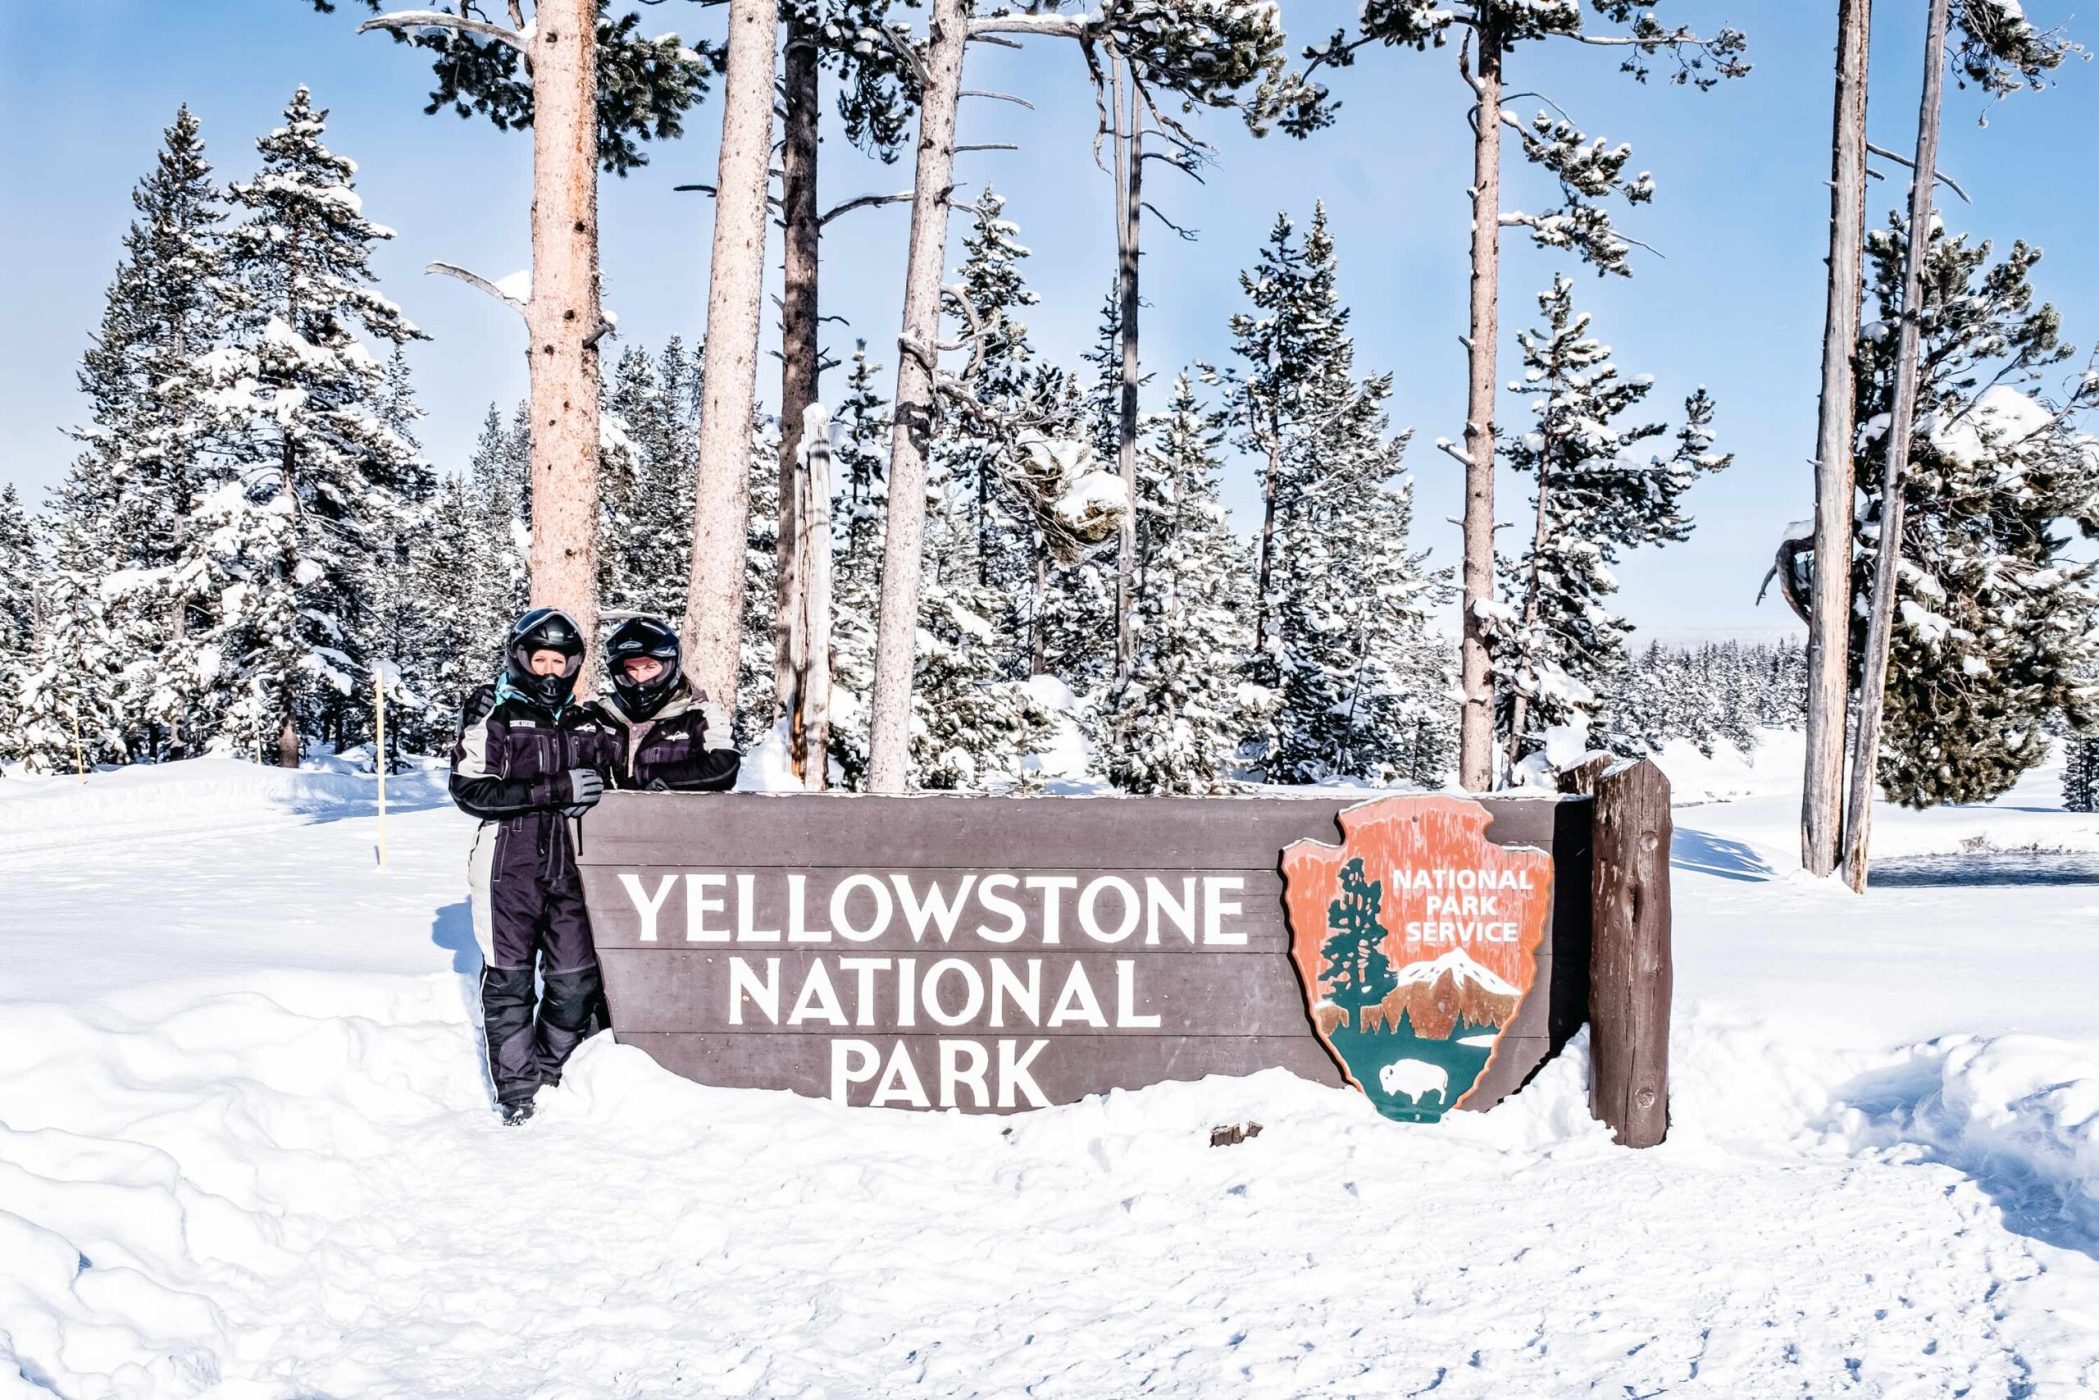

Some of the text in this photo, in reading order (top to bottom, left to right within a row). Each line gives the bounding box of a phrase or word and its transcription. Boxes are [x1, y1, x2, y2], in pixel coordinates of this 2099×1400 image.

[1393, 869, 1533, 891] NATIONAL
[618, 873, 1248, 945] YELLOWSTONE
[1426, 895, 1499, 916] PARK
[1405, 921, 1518, 943] SERVICE
[728, 957, 1162, 1028] NATIONAL
[831, 1039, 1051, 1109] PARK
